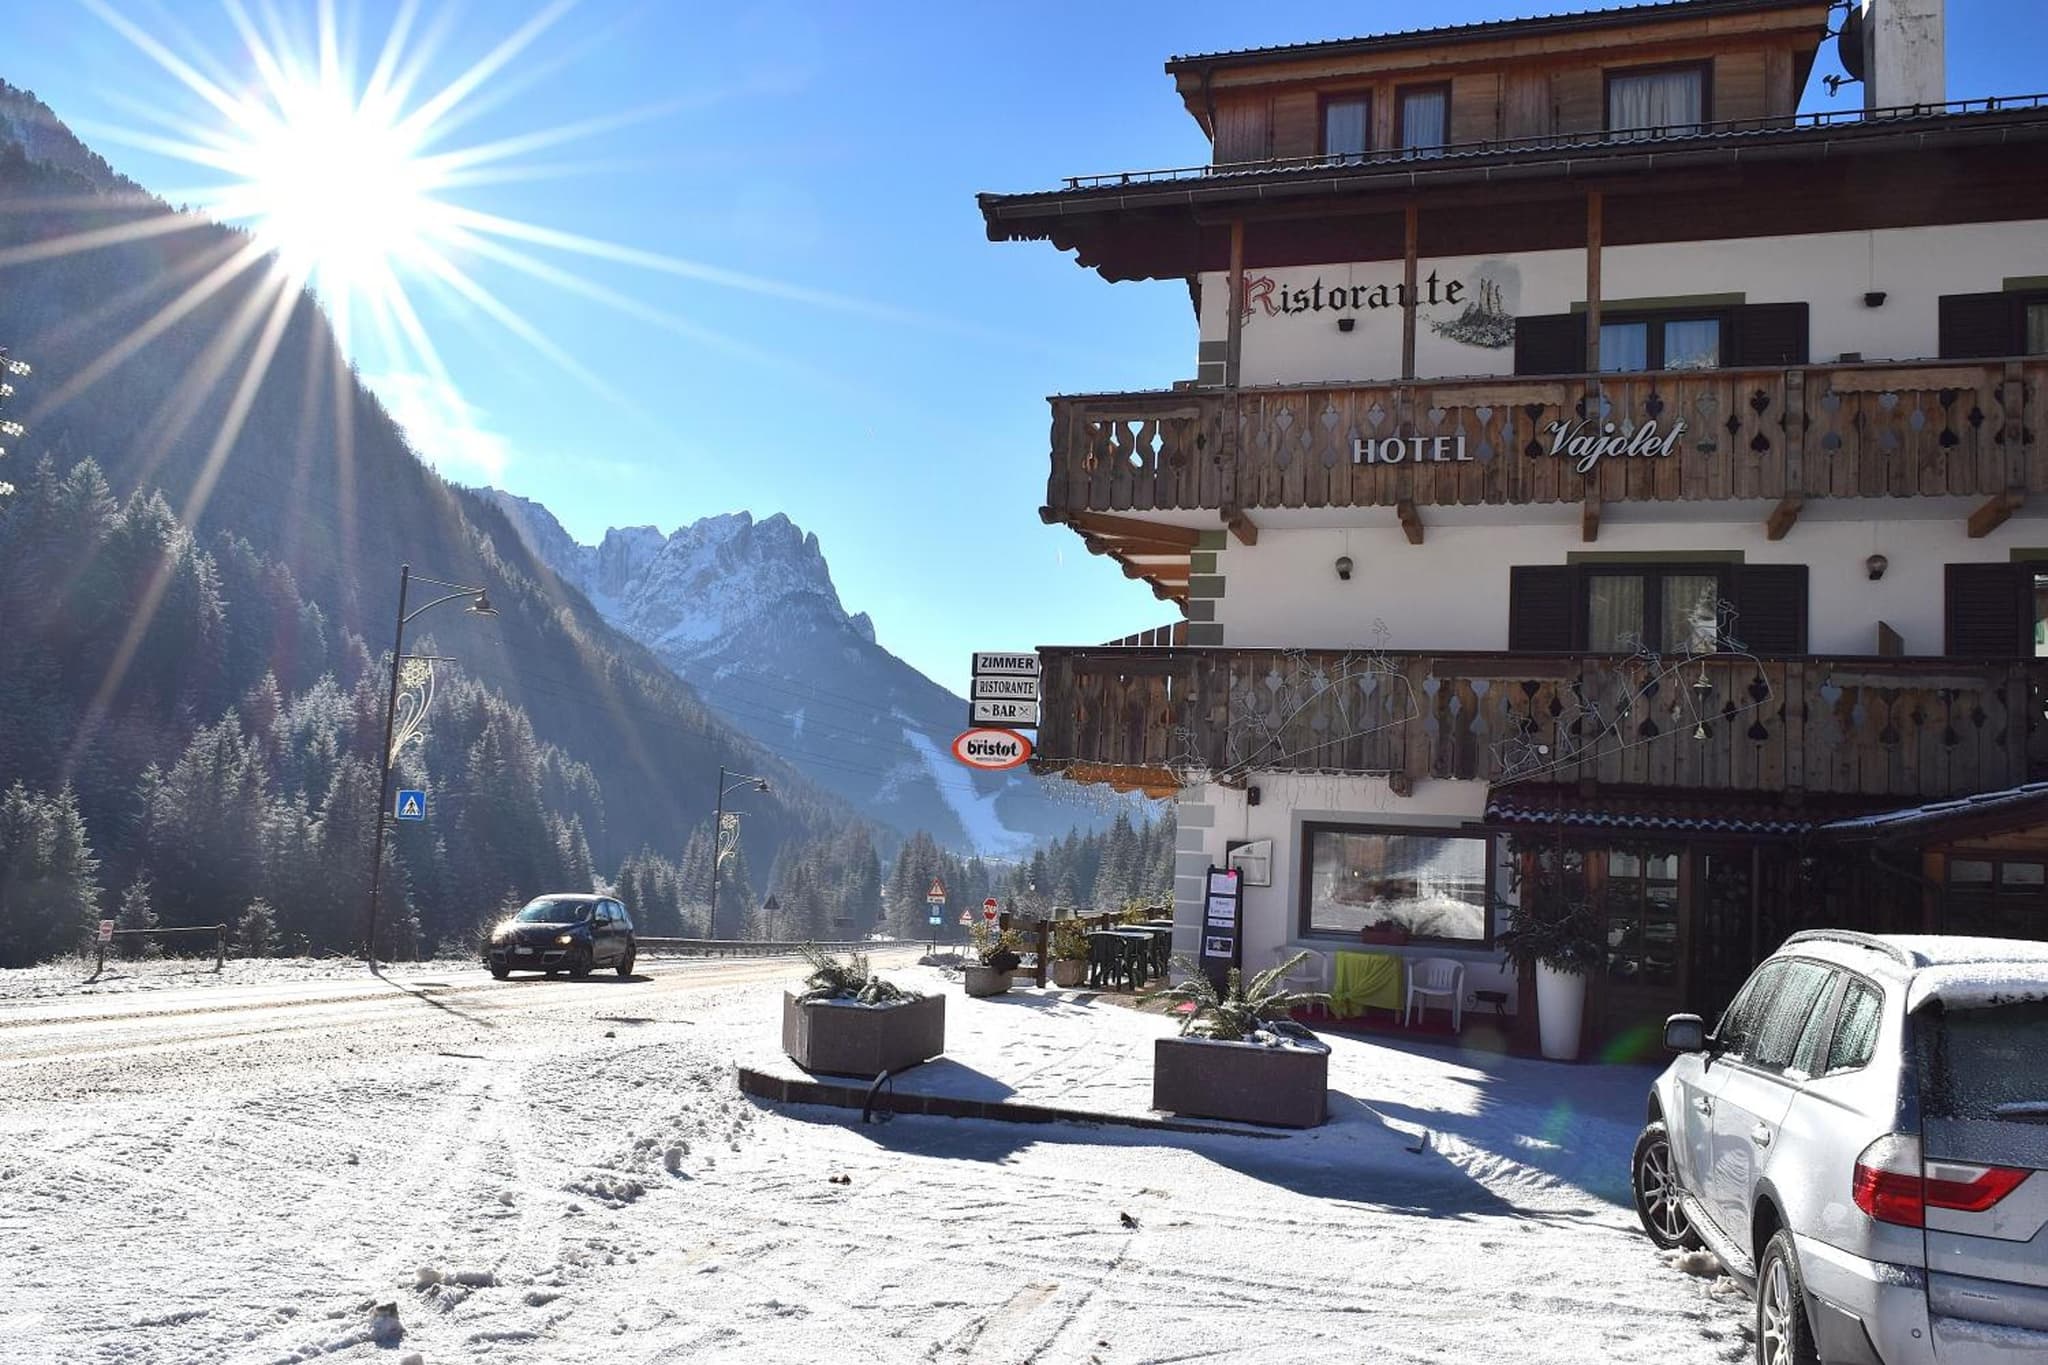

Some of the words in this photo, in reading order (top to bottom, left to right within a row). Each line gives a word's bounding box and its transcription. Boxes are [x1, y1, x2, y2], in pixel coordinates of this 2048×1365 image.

[1353, 435, 1474, 464] HOTEL
[1544, 417, 1687, 473] Vajolet
[981, 656, 1034, 669] ZIMMER
[979, 680, 1034, 694] RISTORANTE
[992, 704, 1016, 717] BAR
[967, 739, 1017, 756] bristot
